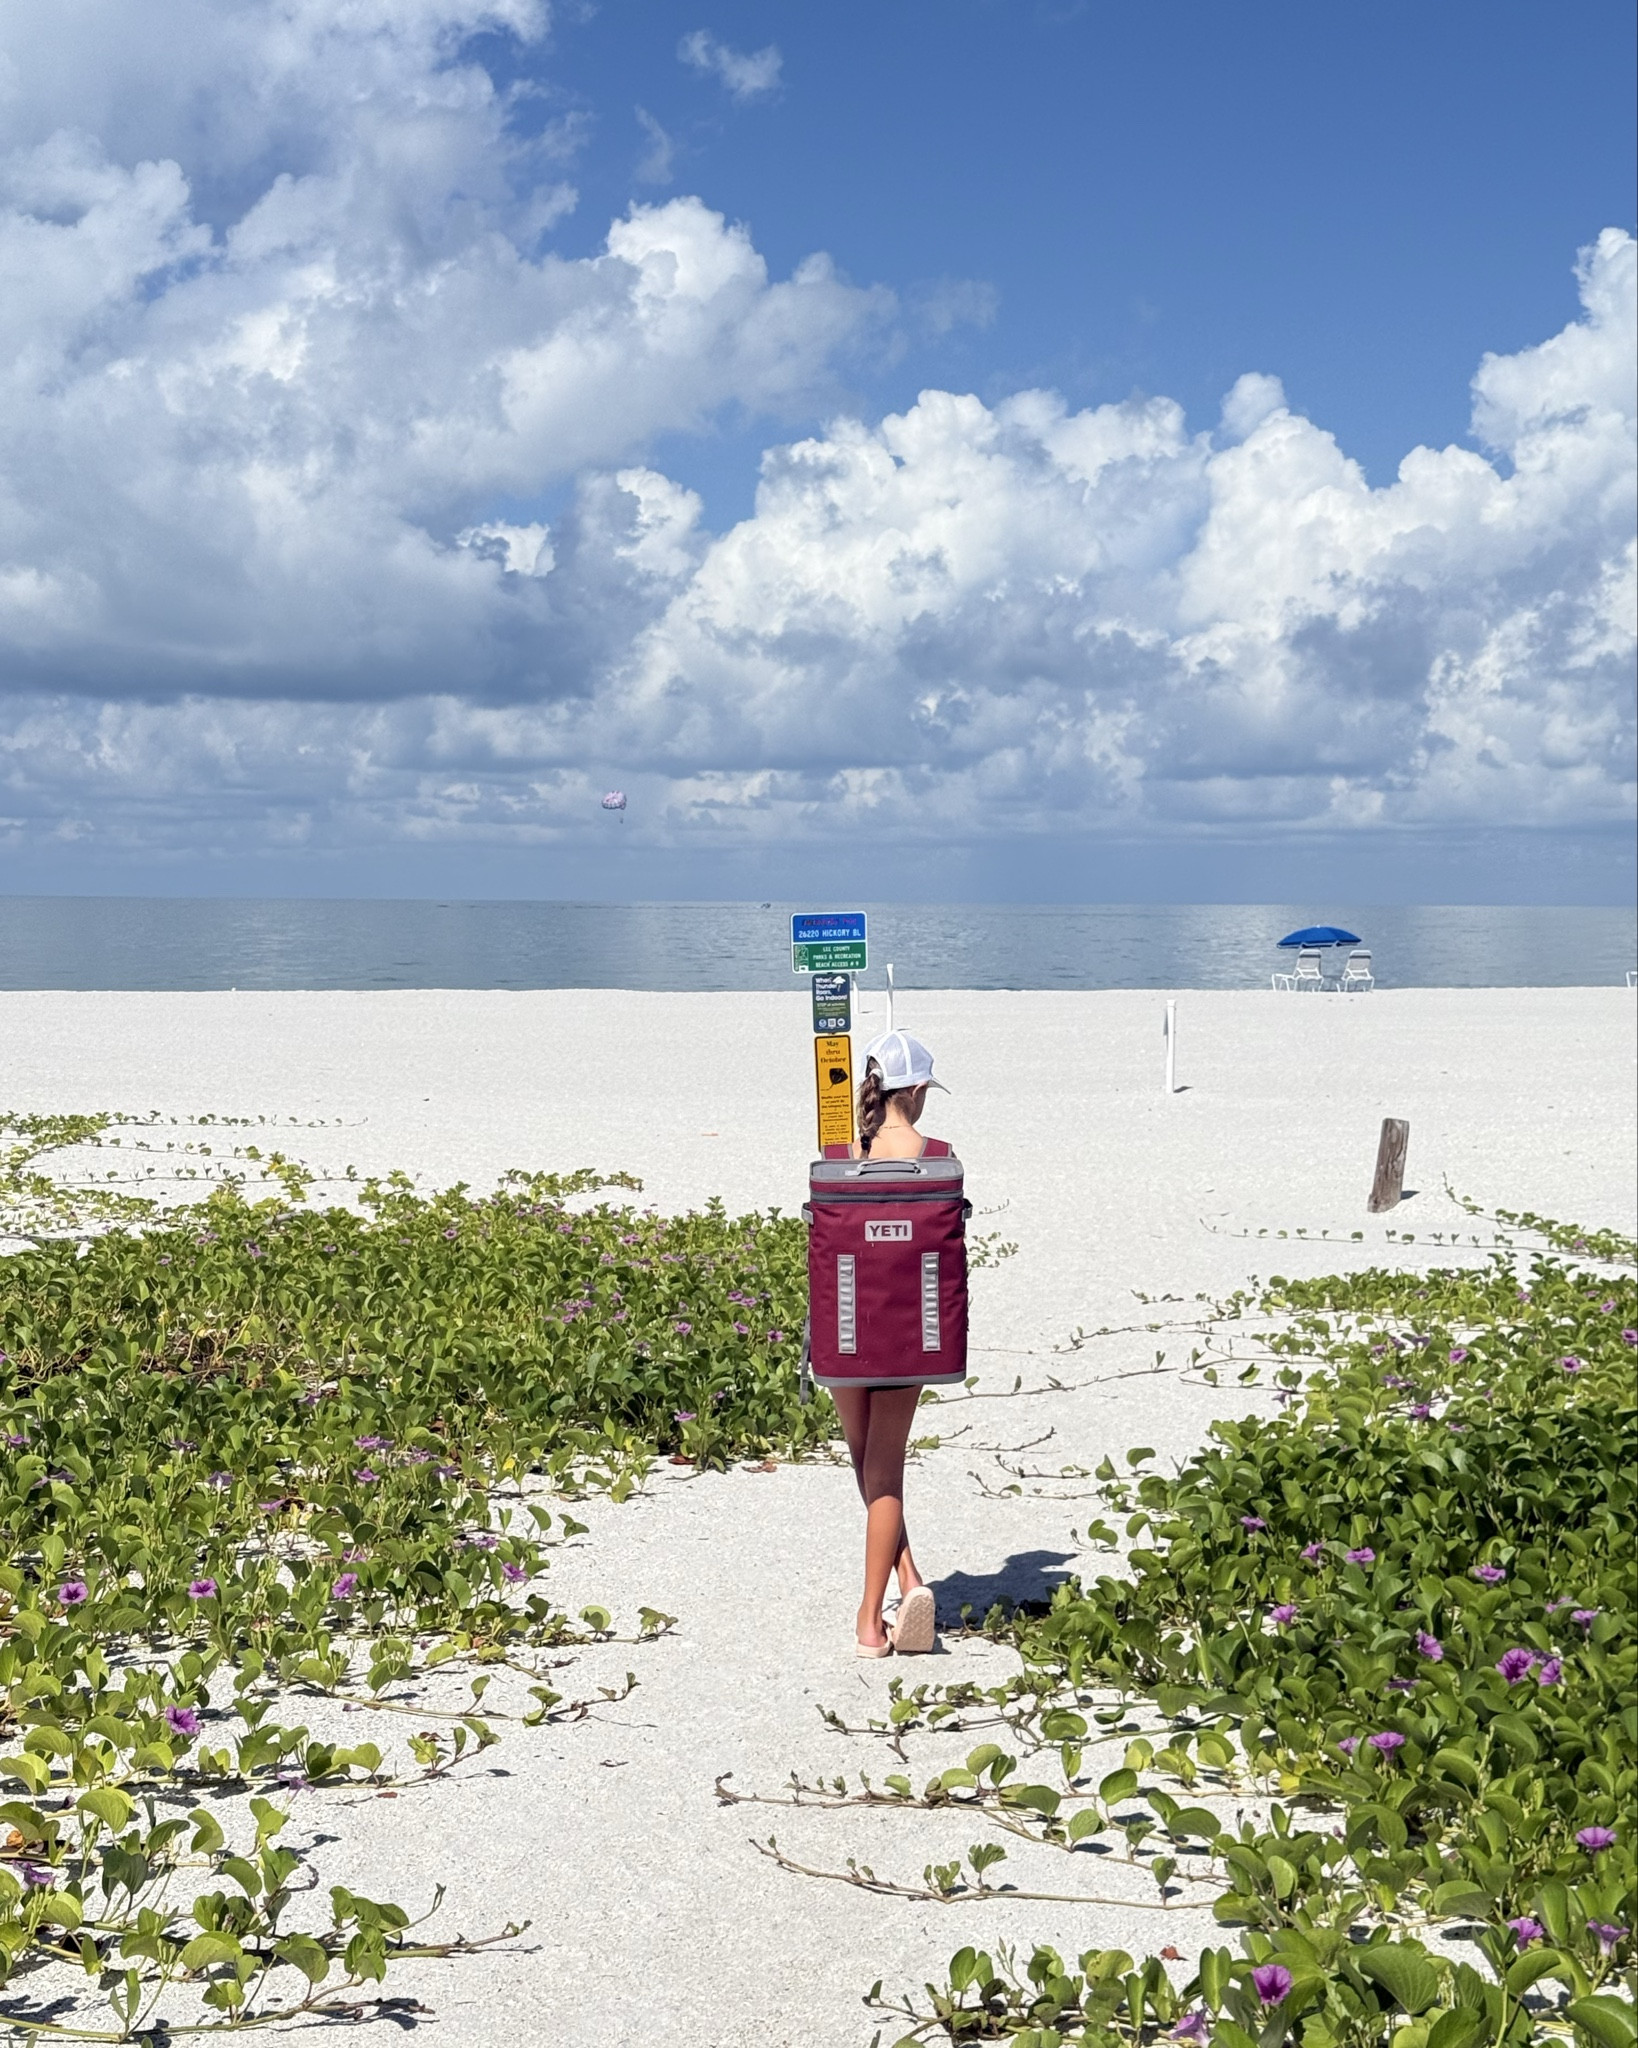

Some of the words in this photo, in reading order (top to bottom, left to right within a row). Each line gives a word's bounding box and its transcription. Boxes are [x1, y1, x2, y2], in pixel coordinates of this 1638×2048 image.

[798, 929, 820, 939] 26220
[822, 928, 851, 937] HICKORY
[852, 928, 862, 937] BL
[869, 1225, 908, 1237] YETI
